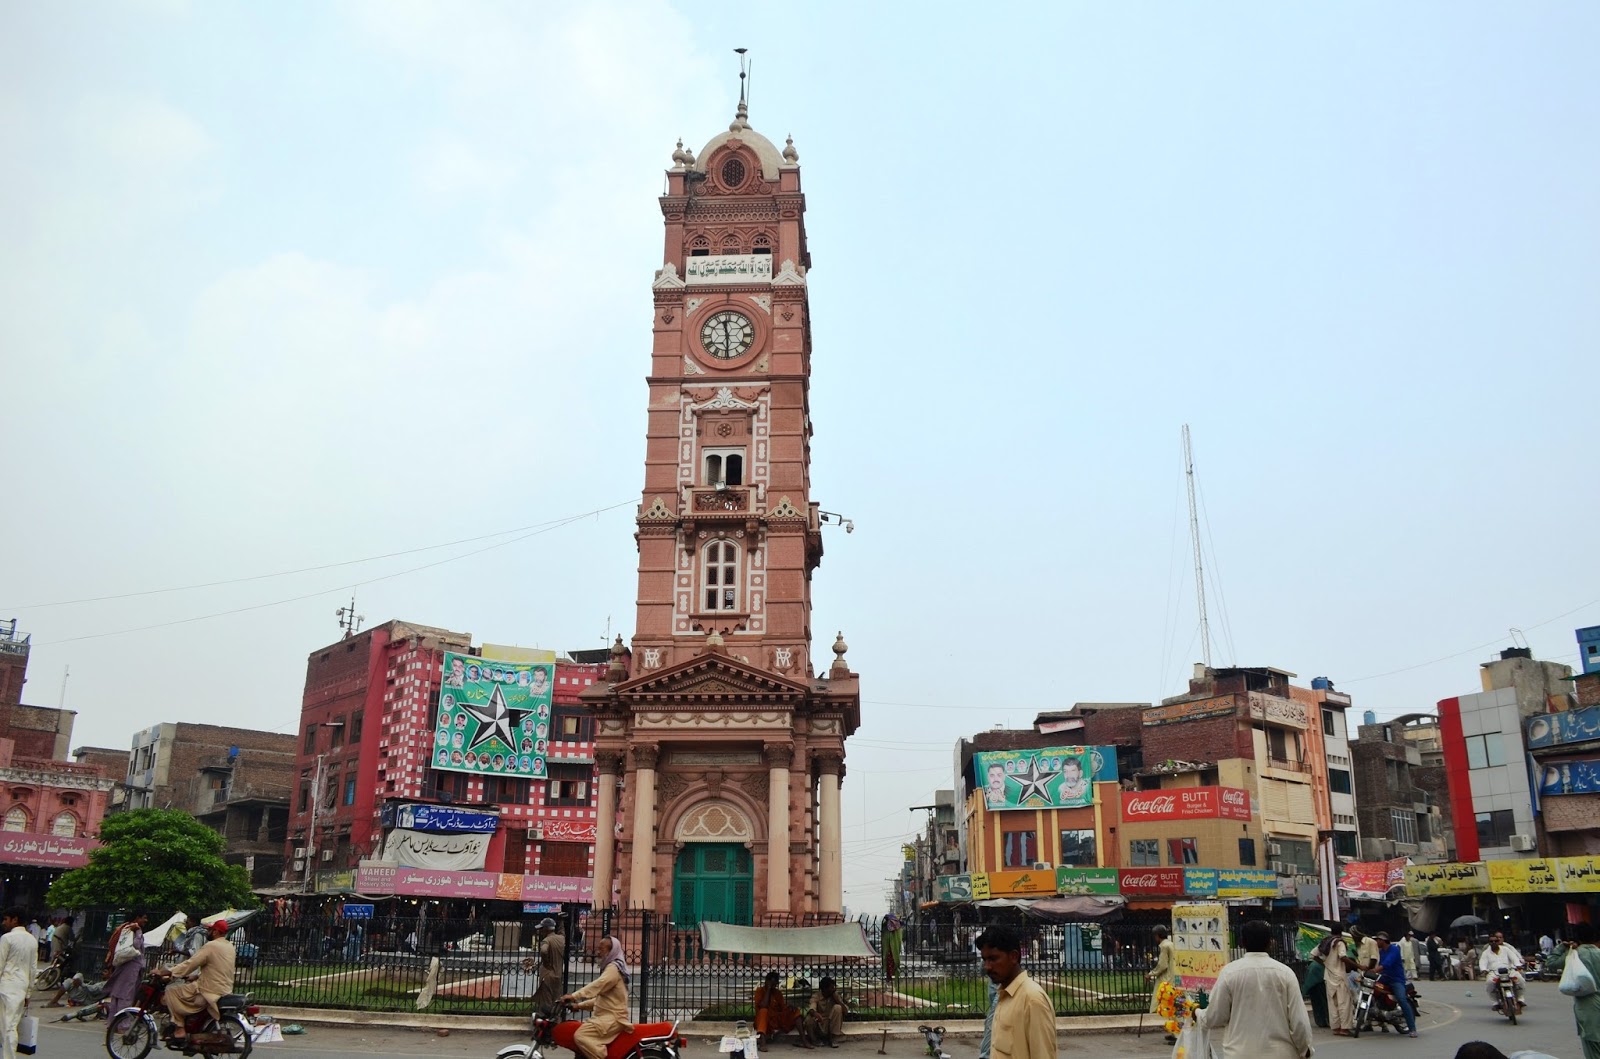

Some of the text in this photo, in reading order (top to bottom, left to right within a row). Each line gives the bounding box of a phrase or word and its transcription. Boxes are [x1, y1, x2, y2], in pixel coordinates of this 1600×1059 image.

[1127, 791, 1209, 815] Coca-Cola BUTT
[57, 842, 84, 857] مبشر
[360, 868, 396, 876] WAHEED
[1528, 861, 1550, 873] رشید
[1565, 864, 1576, 879] بار
[1061, 874, 1071, 885] بار
[1121, 873, 1158, 887] Coca-Cola
[1415, 870, 1427, 882] بار
[474, 878, 494, 888] وحید
[558, 881, 577, 892] مقبول
